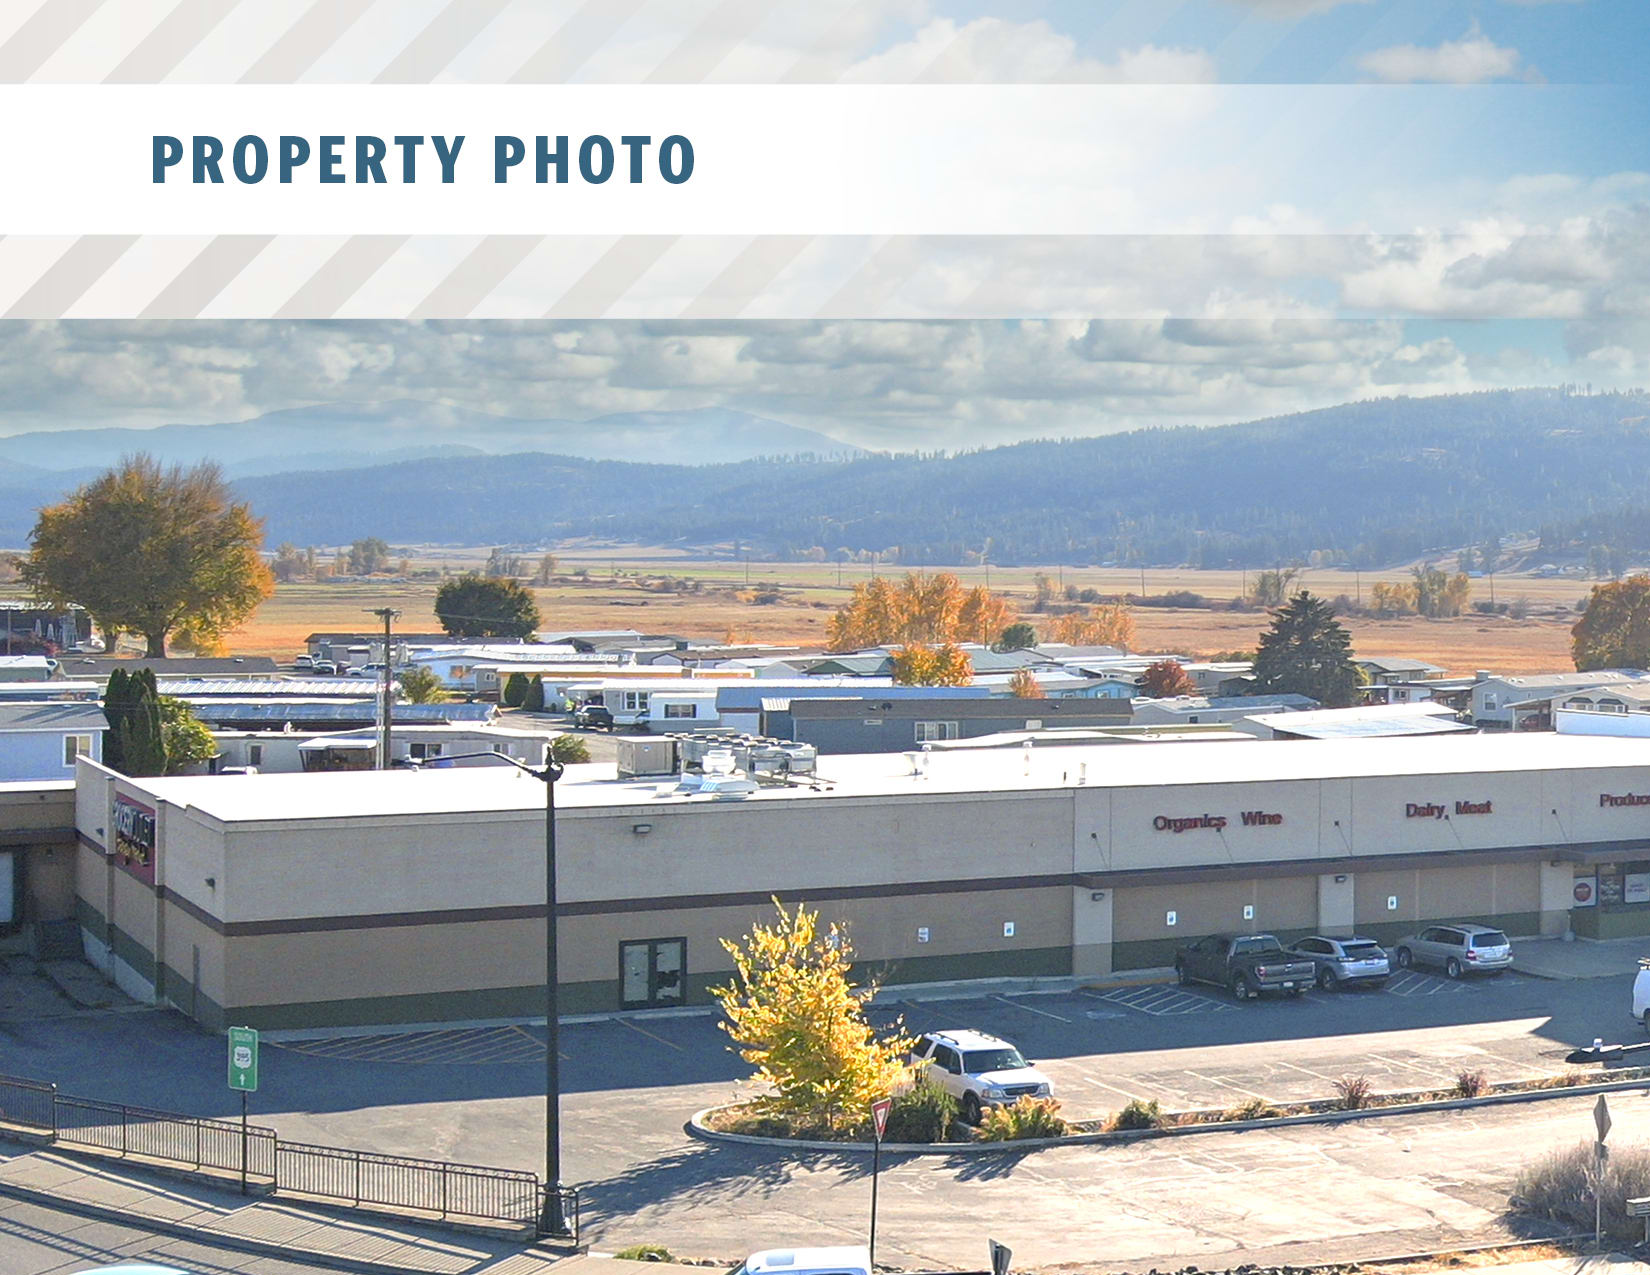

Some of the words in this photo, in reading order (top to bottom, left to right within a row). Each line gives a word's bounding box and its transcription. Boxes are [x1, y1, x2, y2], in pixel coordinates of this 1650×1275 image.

[1406, 802, 1445, 819] Dairy
[1455, 800, 1493, 815] Meat
[1153, 813, 1227, 833] Organics
[1241, 810, 1283, 826] Wine
